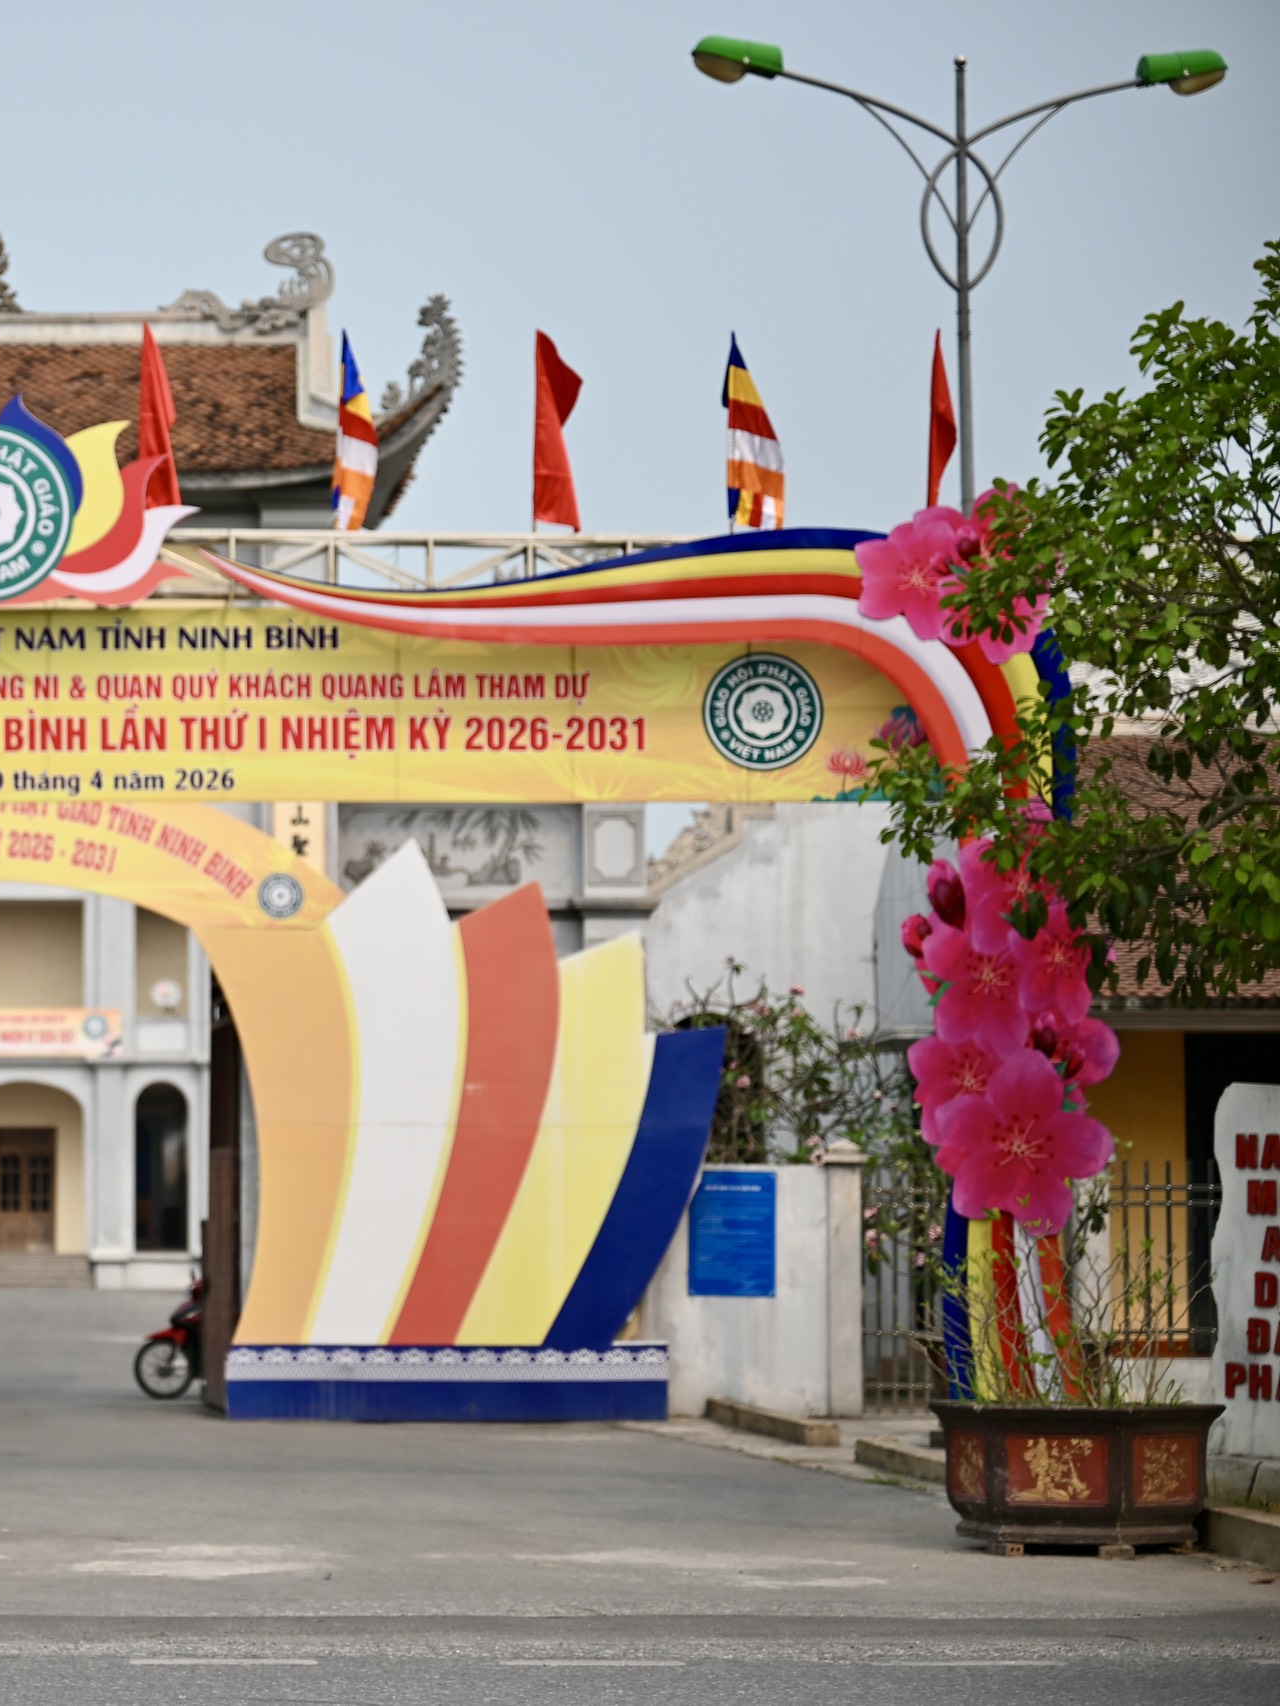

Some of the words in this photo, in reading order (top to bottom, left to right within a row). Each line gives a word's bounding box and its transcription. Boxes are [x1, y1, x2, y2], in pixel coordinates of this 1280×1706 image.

[32, 477, 61, 537] GIÁO
[13, 624, 87, 651] NAM
[96, 617, 166, 650] TỈNH
[178, 626, 252, 651] NINH
[265, 618, 339, 650] BÌNH
[33, 675, 60, 700] NI
[69, 675, 87, 700] &
[96, 674, 163, 702] QUAN
[171, 668, 220, 703] QUÝ
[228, 668, 312, 700] KHÁCH
[321, 673, 405, 702] QUANG
[413, 668, 467, 700] LÂM
[476, 673, 546, 700] THAM
[554, 670, 592, 706] DỰ
[3, 708, 88, 752] BÌNH
[100, 703, 169, 752] LẦN
[179, 707, 250, 752] THỨ
[258, 716, 268, 751] I
[280, 707, 397, 760] NHIỆM
[408, 706, 453, 752] KỲ
[464, 715, 646, 752] 2026-2031
[763, 737, 797, 761] NAM
[13, 770, 81, 796] tháng
[90, 771, 104, 790] 4
[114, 771, 165, 790] năm
[175, 769, 234, 790] 2026
[8, 829, 55, 863] 2026
[71, 837, 118, 874] 2031
[155, 824, 208, 867] NINH
[1235, 1133, 1280, 1170] NA
[1247, 1179, 1280, 1216] M
[1246, 1318, 1280, 1356] Đ
[1225, 1362, 1280, 1400] PH
